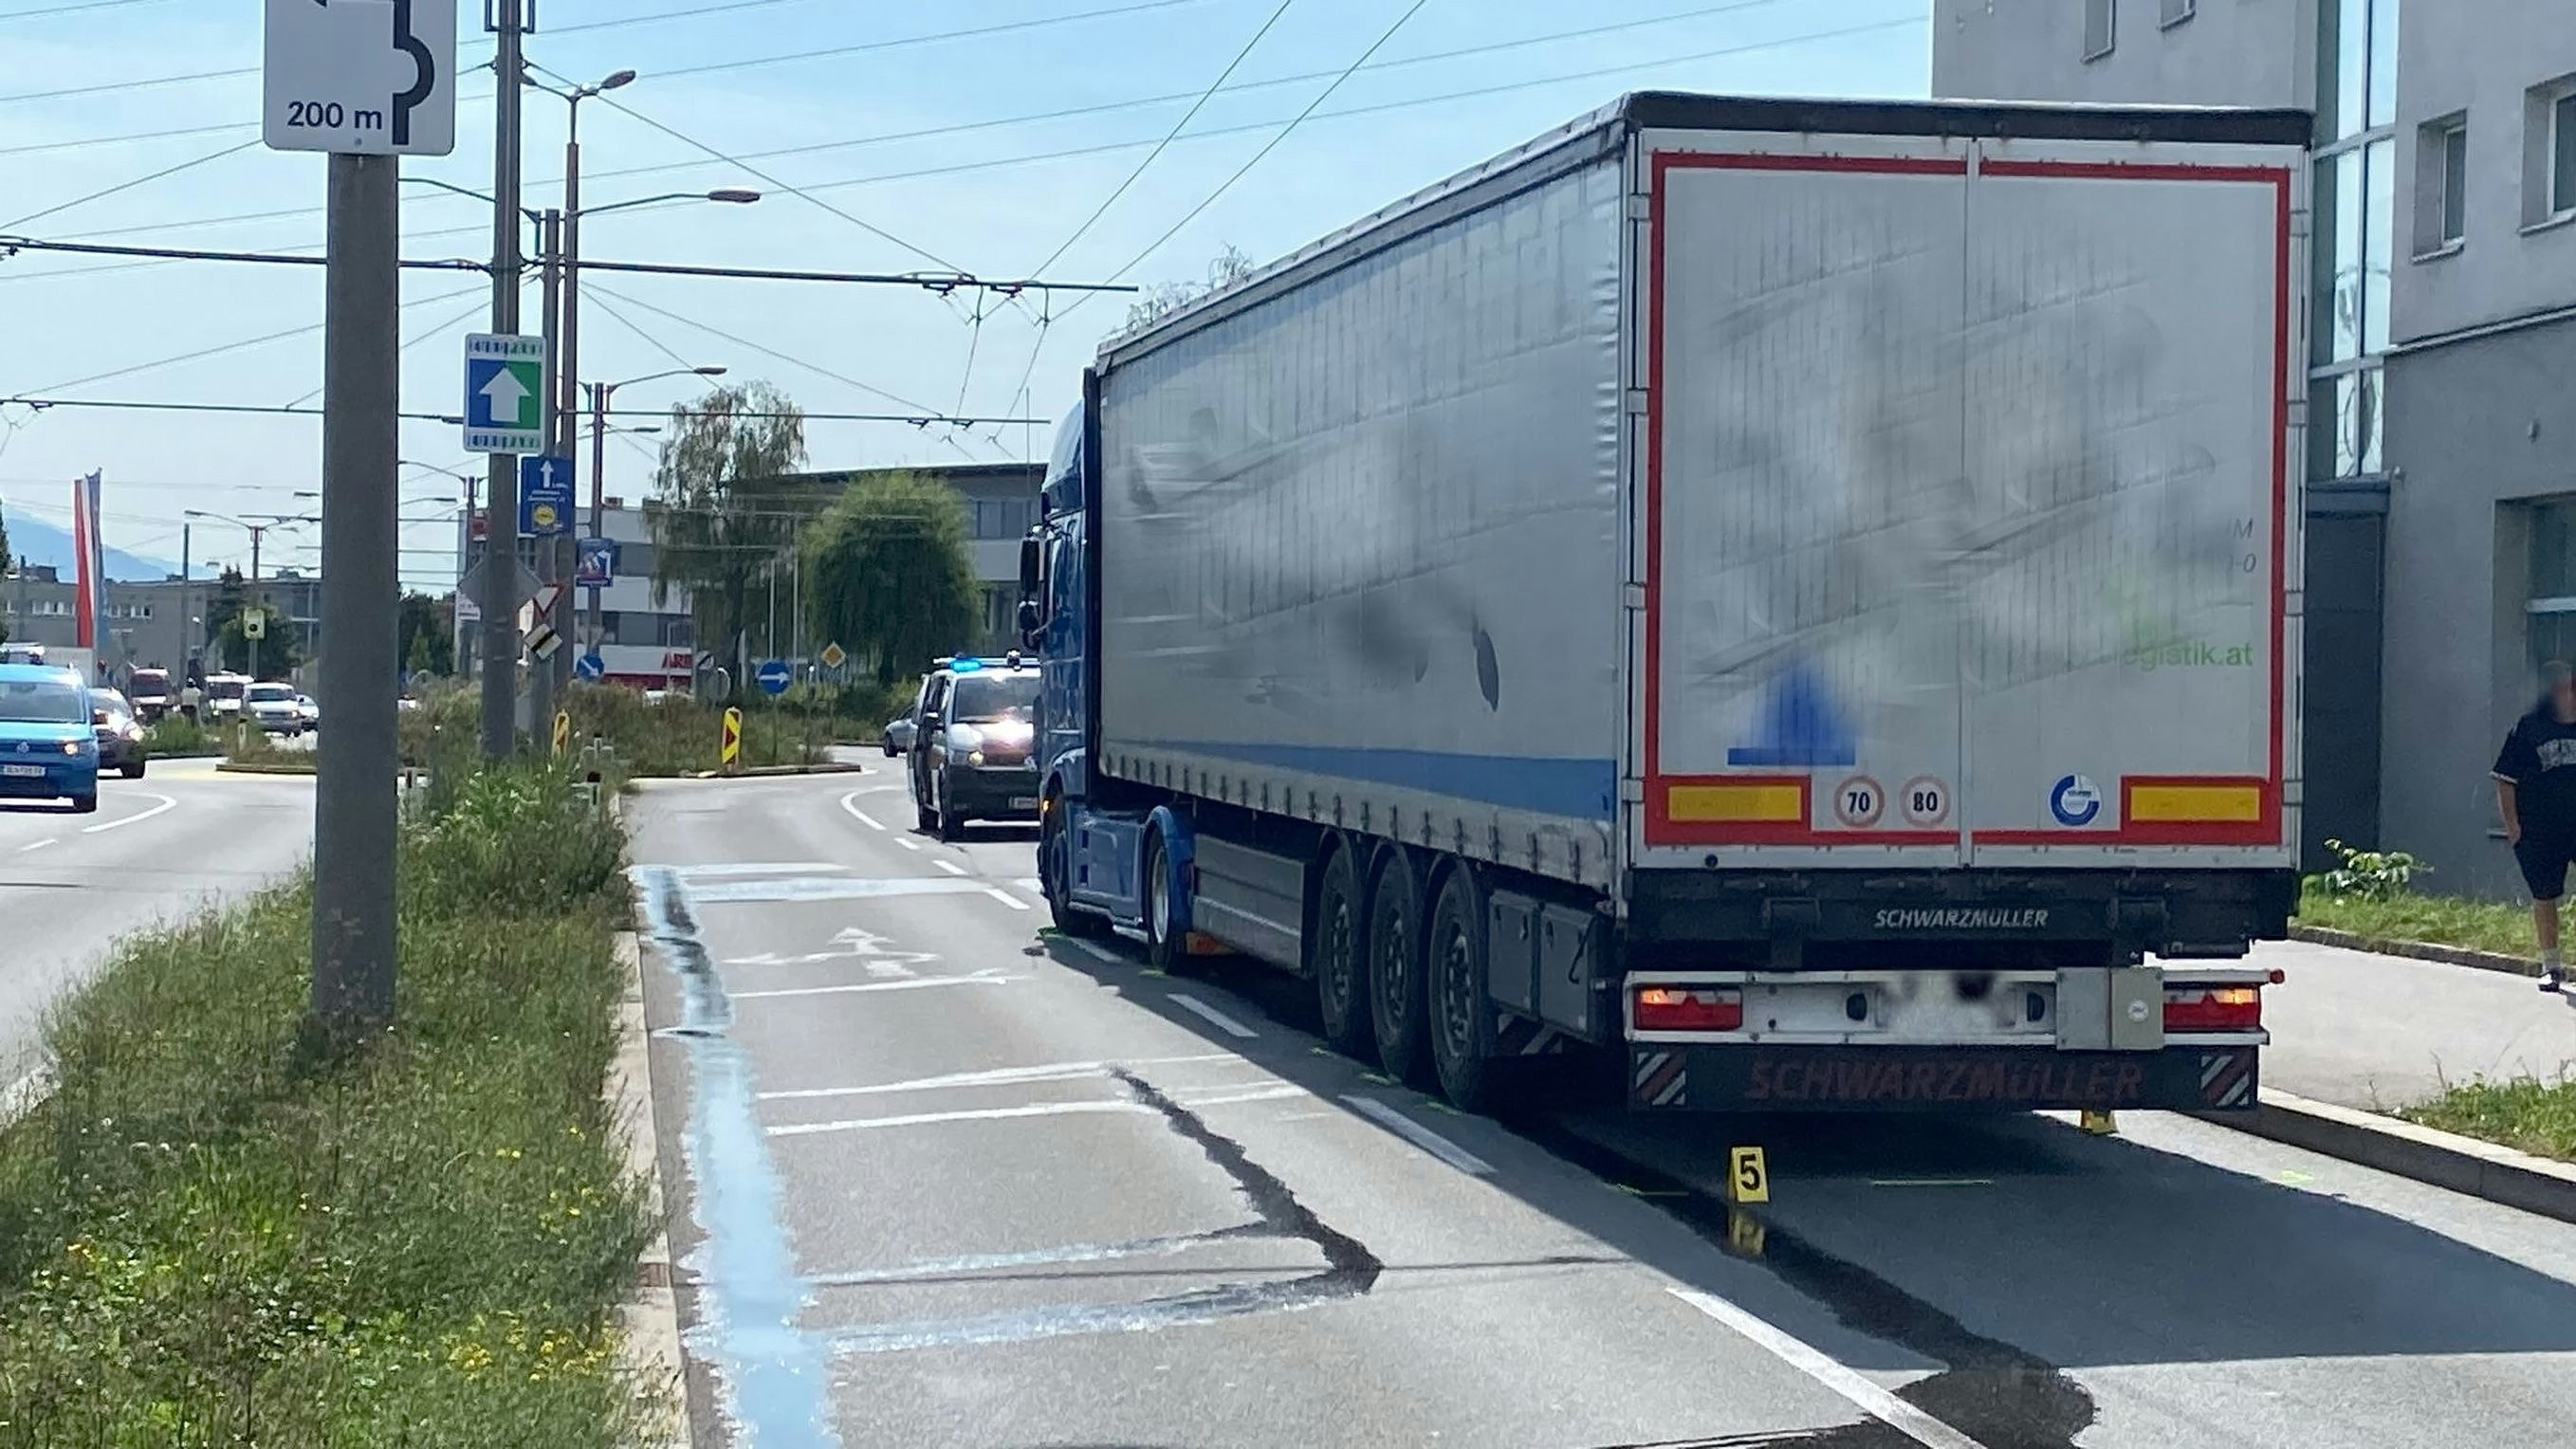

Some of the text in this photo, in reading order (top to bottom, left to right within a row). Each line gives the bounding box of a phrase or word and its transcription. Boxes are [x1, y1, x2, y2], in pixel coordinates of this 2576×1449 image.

[287, 101, 382, 130] 200 m
[1848, 791, 1870, 813] 70
[1913, 791, 1938, 812] 80
[1743, 1059, 2145, 1102] SCHWARZMÜLLER
[1739, 1153, 1760, 1191] 5
